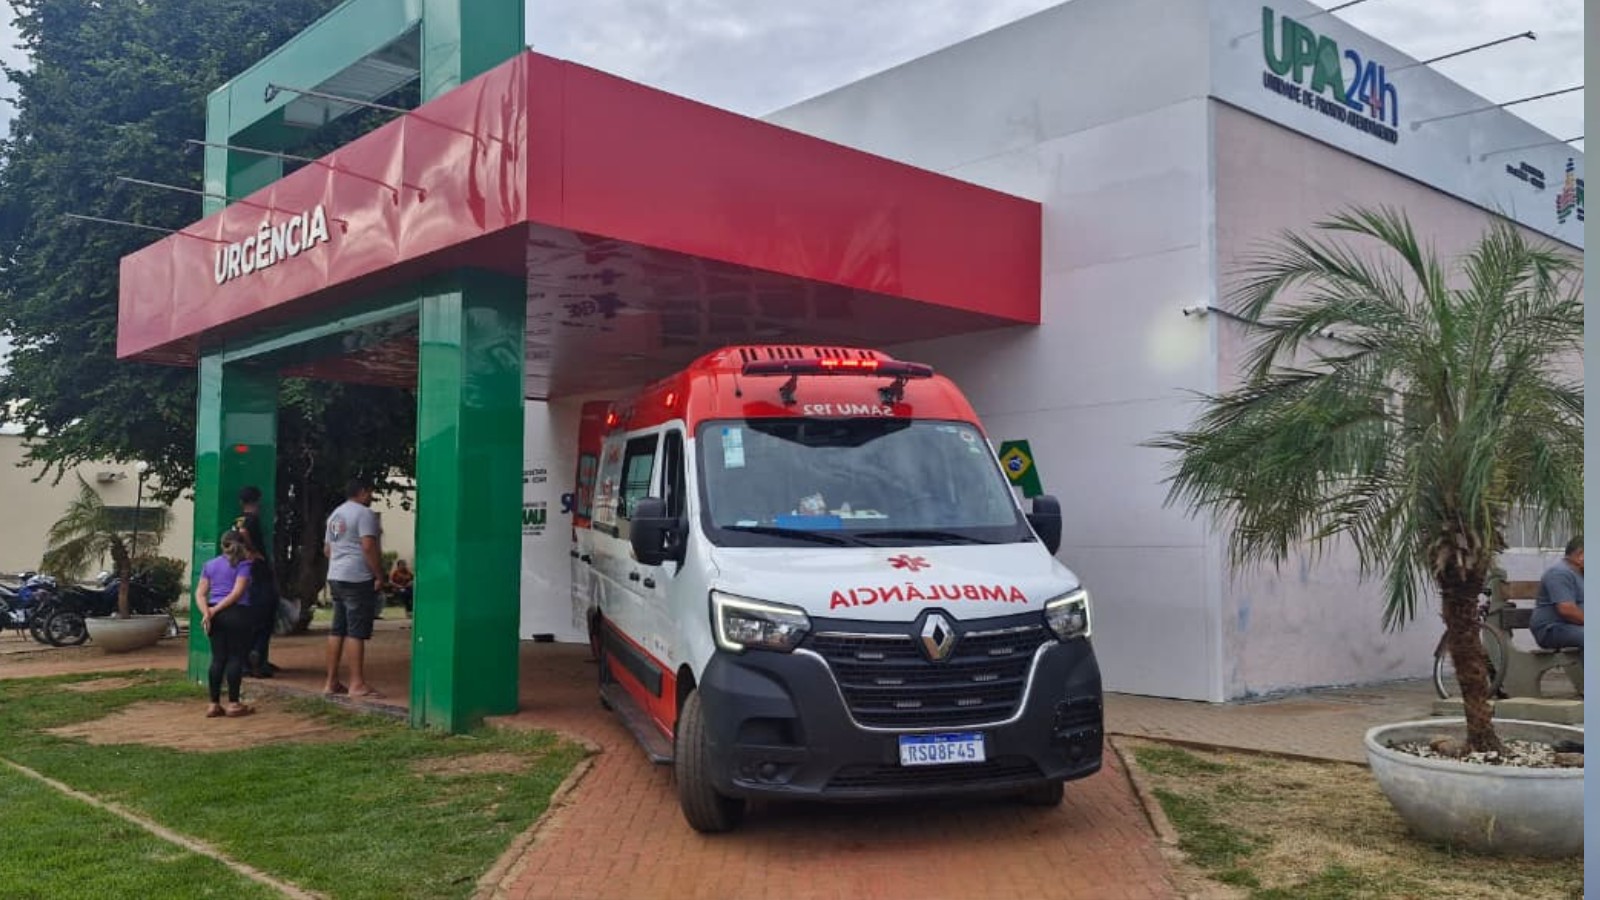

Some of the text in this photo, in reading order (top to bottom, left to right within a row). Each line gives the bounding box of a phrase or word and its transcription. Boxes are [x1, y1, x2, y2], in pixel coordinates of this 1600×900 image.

[1263, 70, 1301, 103] UNIDADE
[1303, 90, 1314, 109] DE
[1347, 110, 1398, 145] ATENDIMENTO
[214, 204, 329, 285] URGÊNCIA
[908, 743, 976, 762] RSQ8F45
